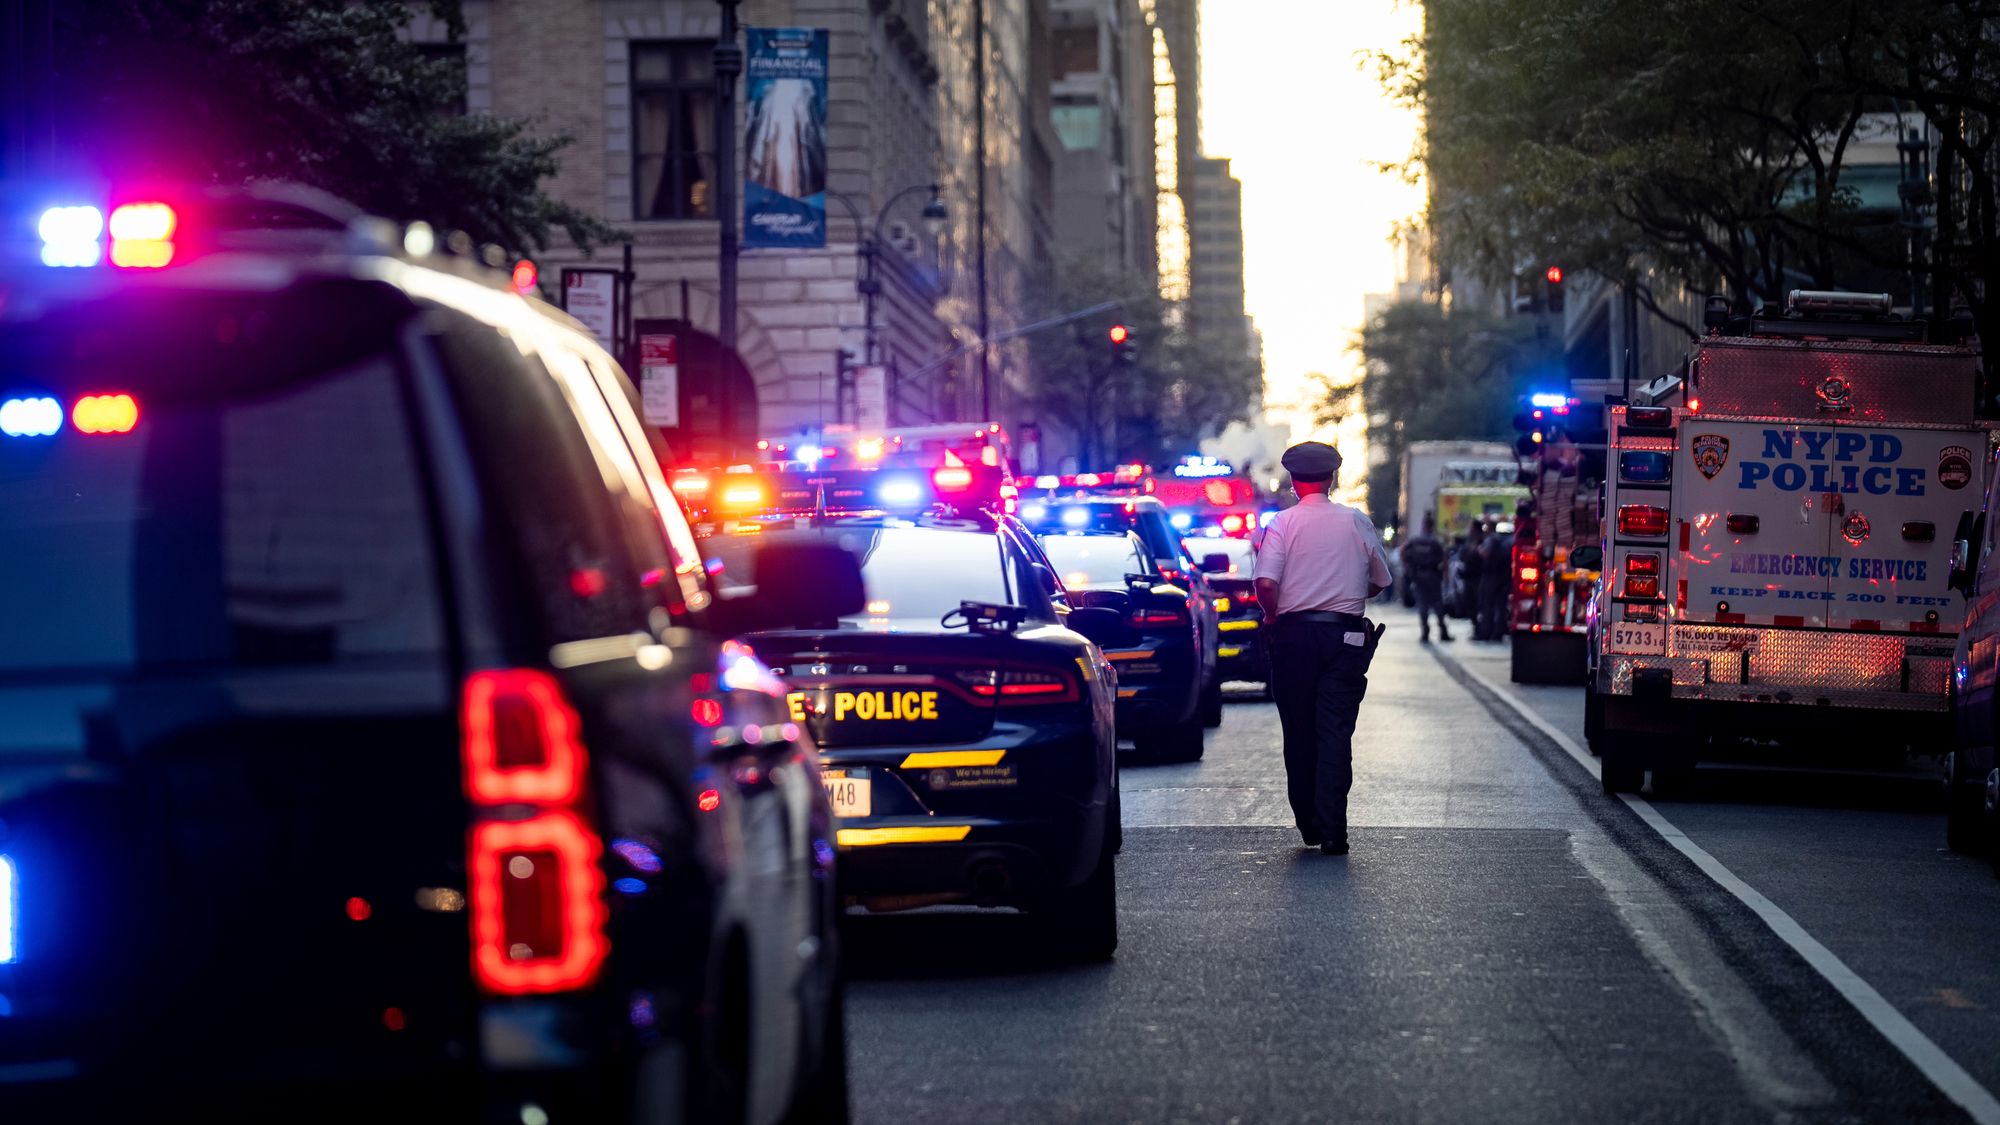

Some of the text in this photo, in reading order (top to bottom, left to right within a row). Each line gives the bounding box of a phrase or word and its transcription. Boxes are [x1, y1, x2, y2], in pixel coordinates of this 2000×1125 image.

[751, 57, 821, 69] FINANCIAL
[1762, 429, 1902, 463] NYPD
[1940, 447, 1970, 459] POLICE
[1738, 461, 1926, 496] POLICE
[1730, 553, 1927, 582] EMERGENCY SERVICE
[1710, 586, 1951, 606] KEEP BACK 200 FEET
[1615, 630, 1651, 645] 5733
[1717, 632, 1757, 643] REWARD
[834, 691, 938, 721] POLICE
